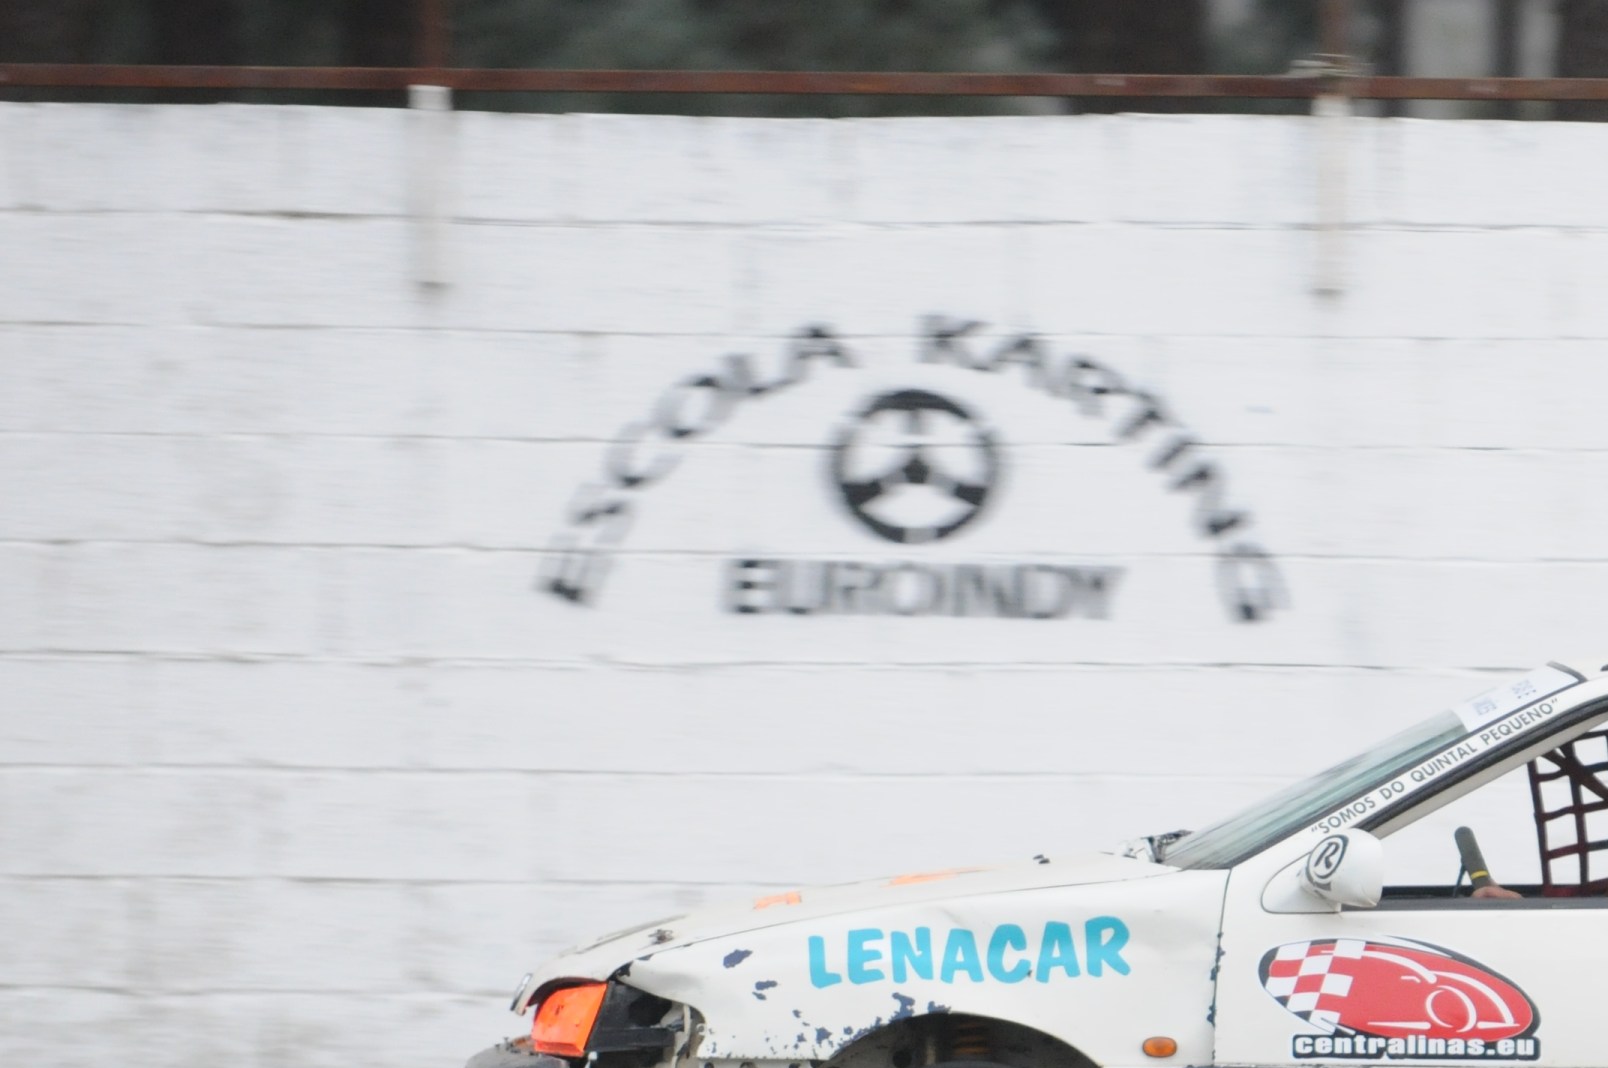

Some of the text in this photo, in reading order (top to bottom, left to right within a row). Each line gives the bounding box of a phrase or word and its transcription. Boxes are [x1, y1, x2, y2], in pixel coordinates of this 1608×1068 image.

[533, 312, 1291, 623] ESCOLA KARTING
[721, 558, 1125, 619] EUROINDY
[1380, 781, 1405, 800] DO
[1410, 743, 1477, 782] QUINTAL
[808, 916, 1132, 989] LENACAR
[1295, 1034, 1535, 1058] centralinas.eu
